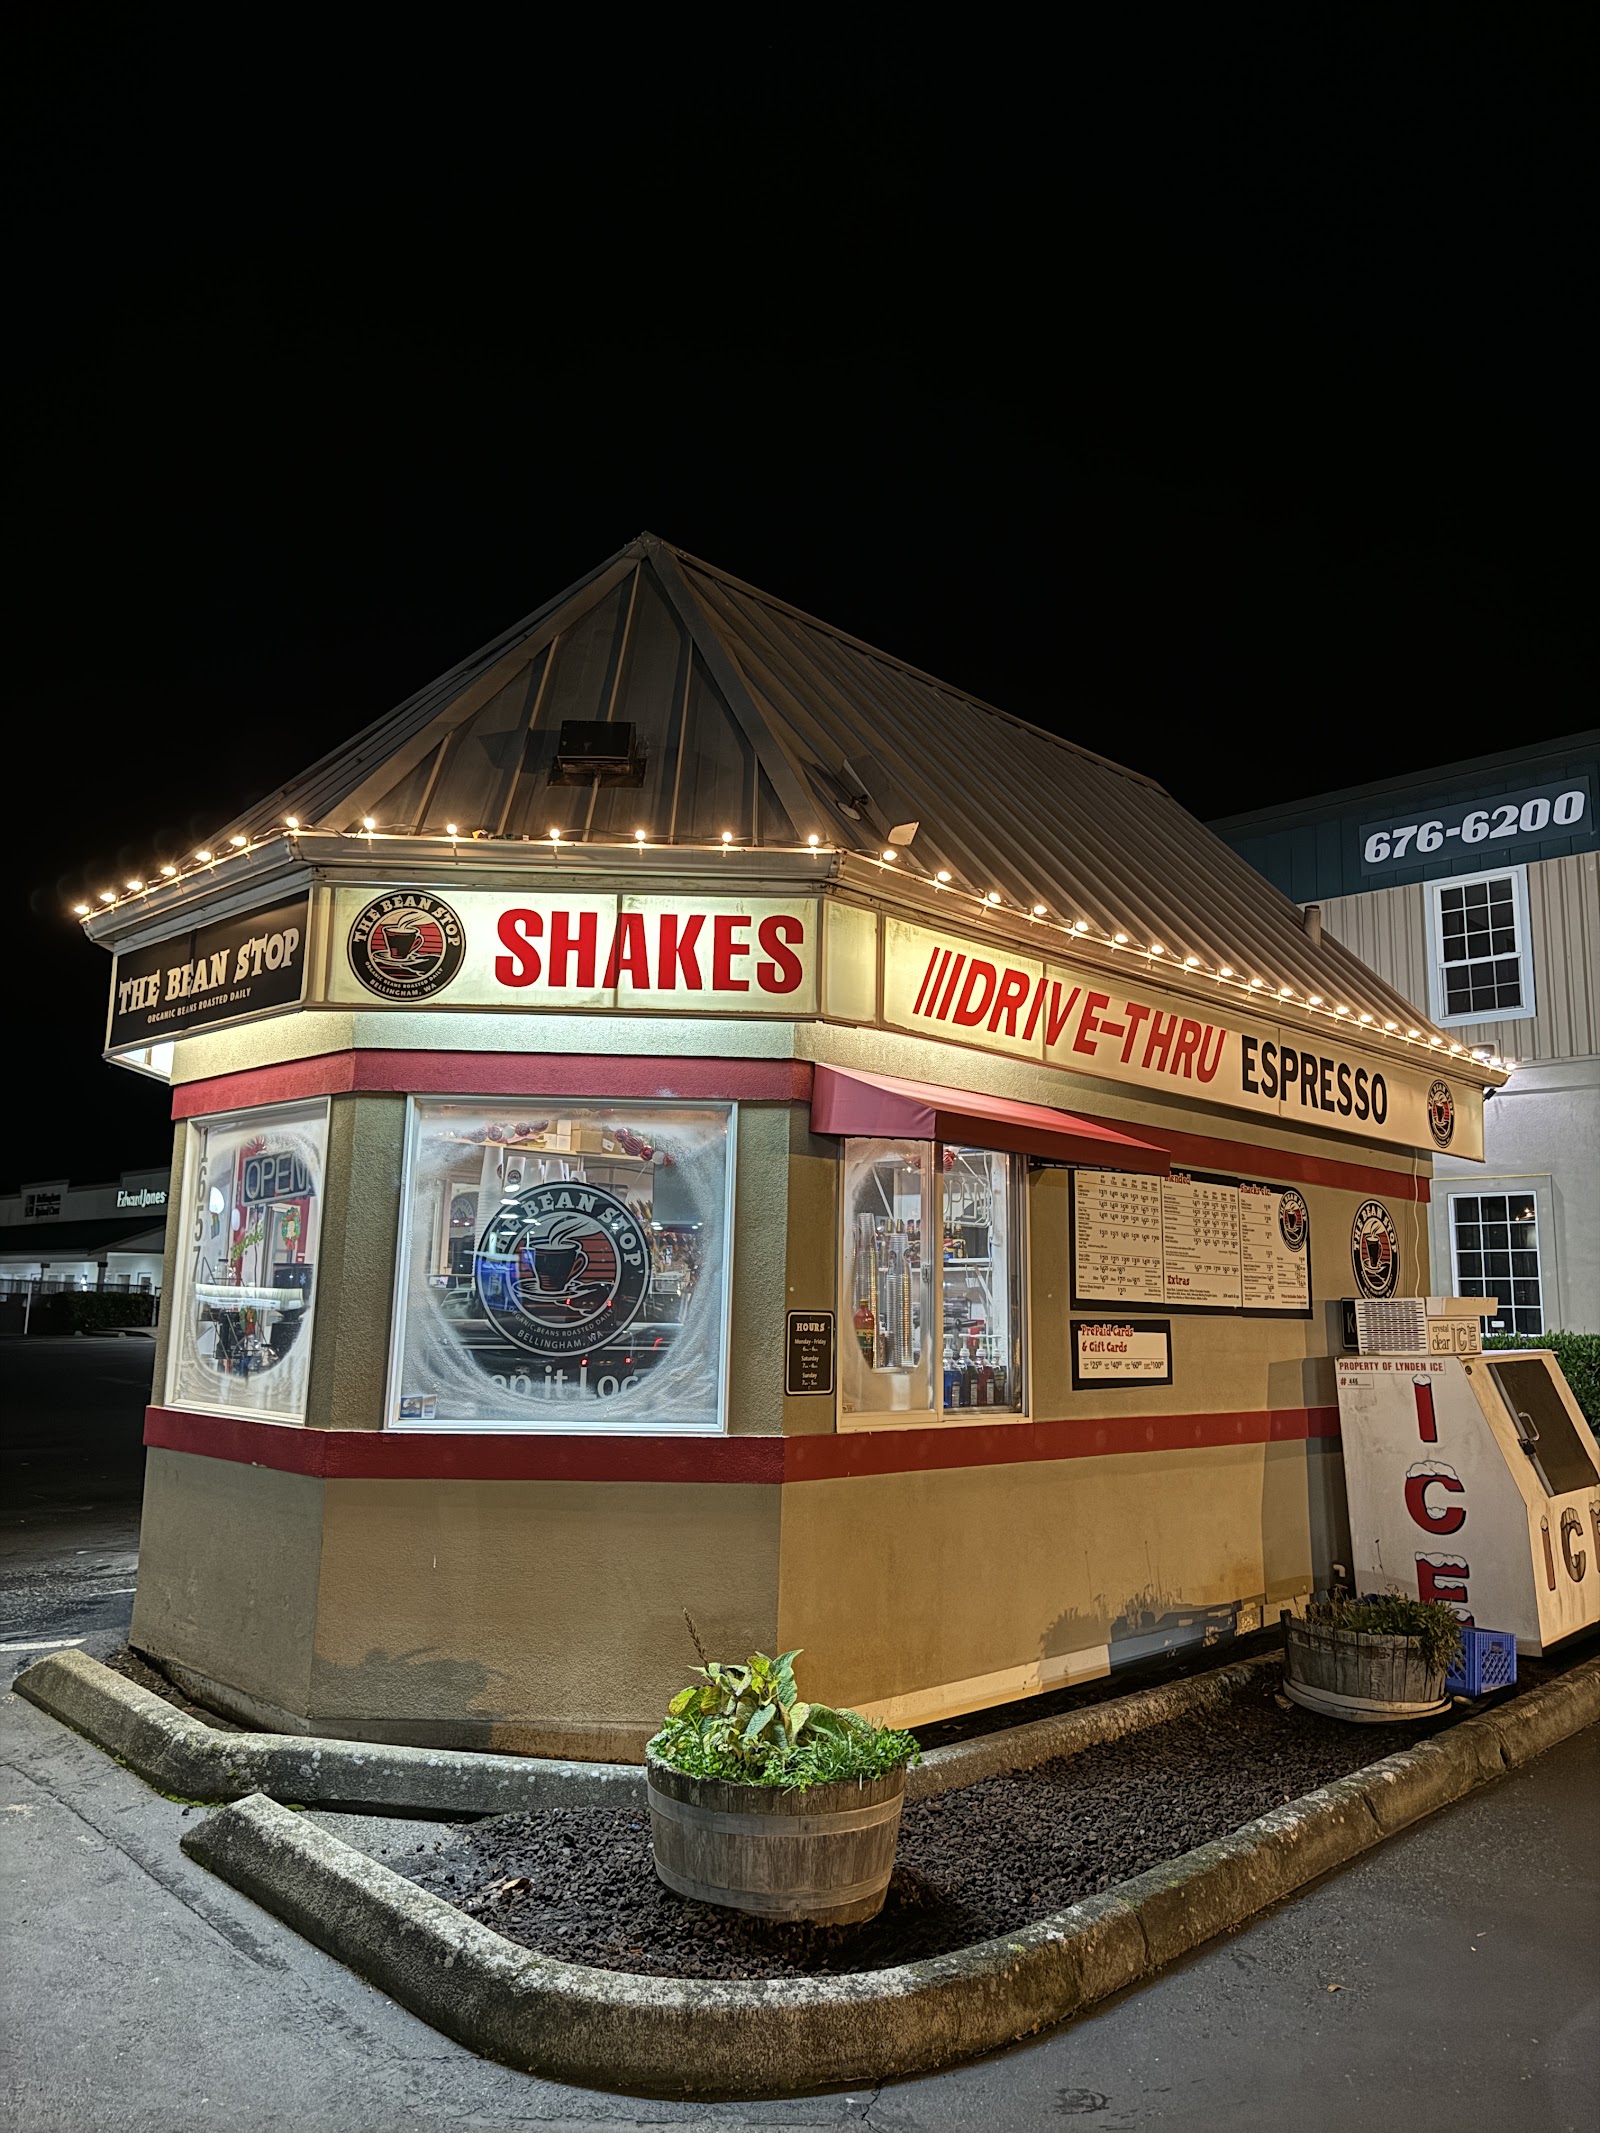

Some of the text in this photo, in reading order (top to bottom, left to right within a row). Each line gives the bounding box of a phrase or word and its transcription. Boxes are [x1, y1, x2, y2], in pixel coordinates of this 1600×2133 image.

[1364, 791, 1586, 864] 676-6200
[353, 895, 461, 946] THE BEAN STOP
[495, 908, 804, 994] SHAKES
[118, 927, 300, 1016] THE BEAN STOP
[365, 961, 444, 989] ORGANIC BEANS ROASTED DAILY
[369, 979, 437, 997] BELLINGHAM, WA
[147, 988, 252, 1024] ORGANIC BEANS ROASTED DAILY
[952, 958, 1226, 1084] DRIVE-THRU
[1241, 1034, 1387, 1125] ESPRESSO
[245, 1152, 307, 1200] OPEN
[117, 1189, 166, 1208] Edward Jones
[1361, 1205, 1383, 1220] BEAN
[521, 1192, 599, 1218] BEAN
[597, 1207, 642, 1268] STOP
[1167, 1274, 1190, 1286] Extras
[508, 1307, 614, 1337] ORGANIC BEANS ROASTED DAILY
[796, 1322, 825, 1332] HOURS
[1081, 1325, 1134, 1337] PrePaid Cards
[1432, 1323, 1450, 1334] crystal
[517, 1329, 604, 1349] BELLINGHAM, WA
[1082, 1341, 1128, 1352] & Gift Cards
[1432, 1335, 1450, 1351] clear
[1339, 1361, 1444, 1372] PROPERTY OF LYNDEN ICE
[544, 1365, 568, 1399] it
[580, 1366, 639, 1399] Loc
[1340, 1377, 1347, 1386] #
[1405, 1374, 1474, 1627] ICE
